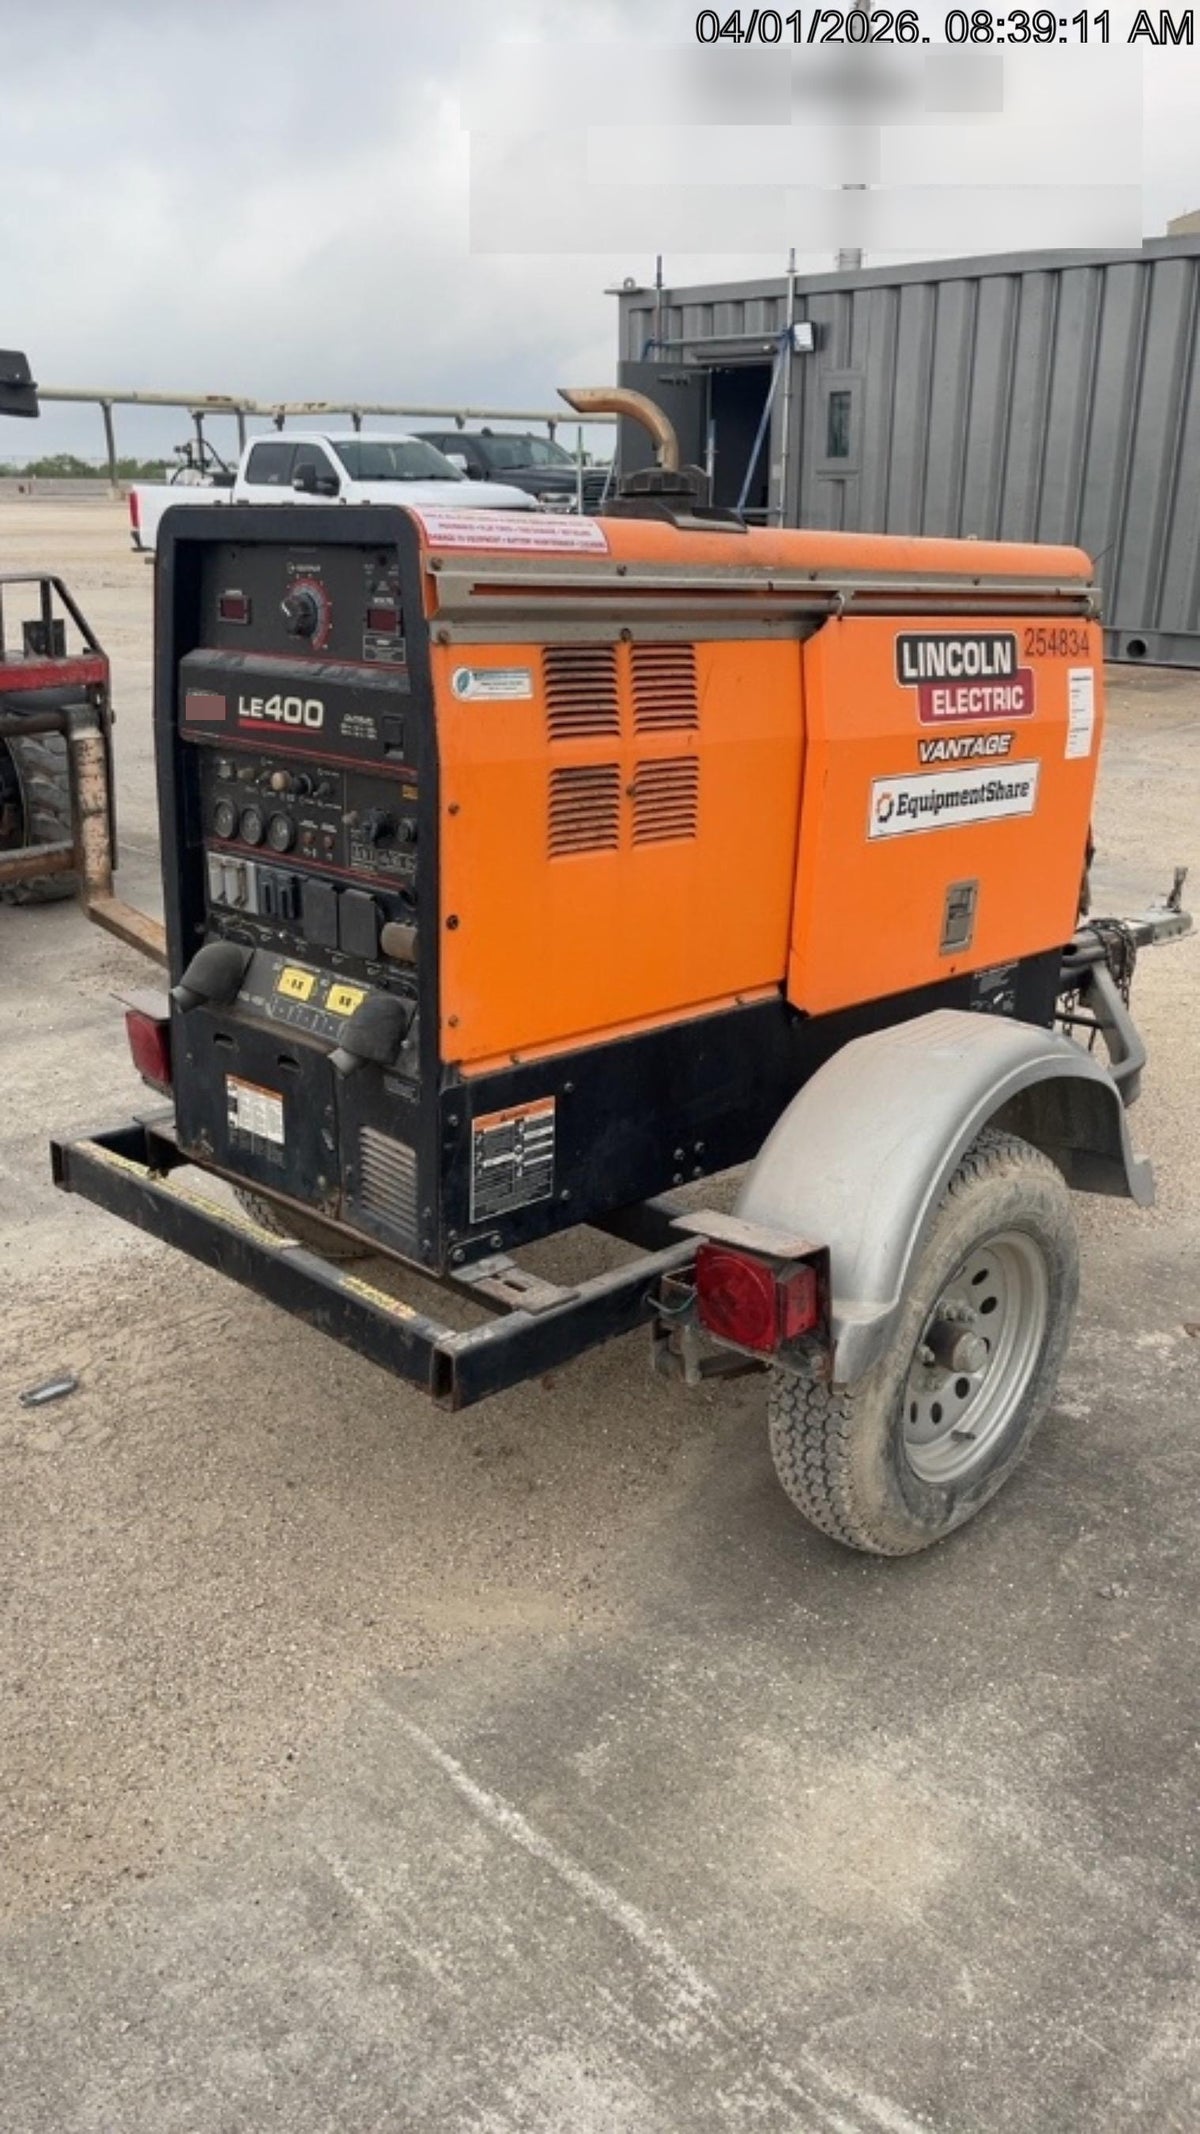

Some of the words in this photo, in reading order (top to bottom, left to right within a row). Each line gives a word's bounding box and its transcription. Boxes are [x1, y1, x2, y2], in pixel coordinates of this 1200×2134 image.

[902, 641, 1012, 678] LINCOLN
[1024, 629, 1090, 658] 254834
[238, 694, 324, 728] LE400
[931, 686, 1024, 716] ELECTRIC
[919, 733, 1014, 763] VANTAGE
[896, 781, 1029, 818] EquipmentShare
